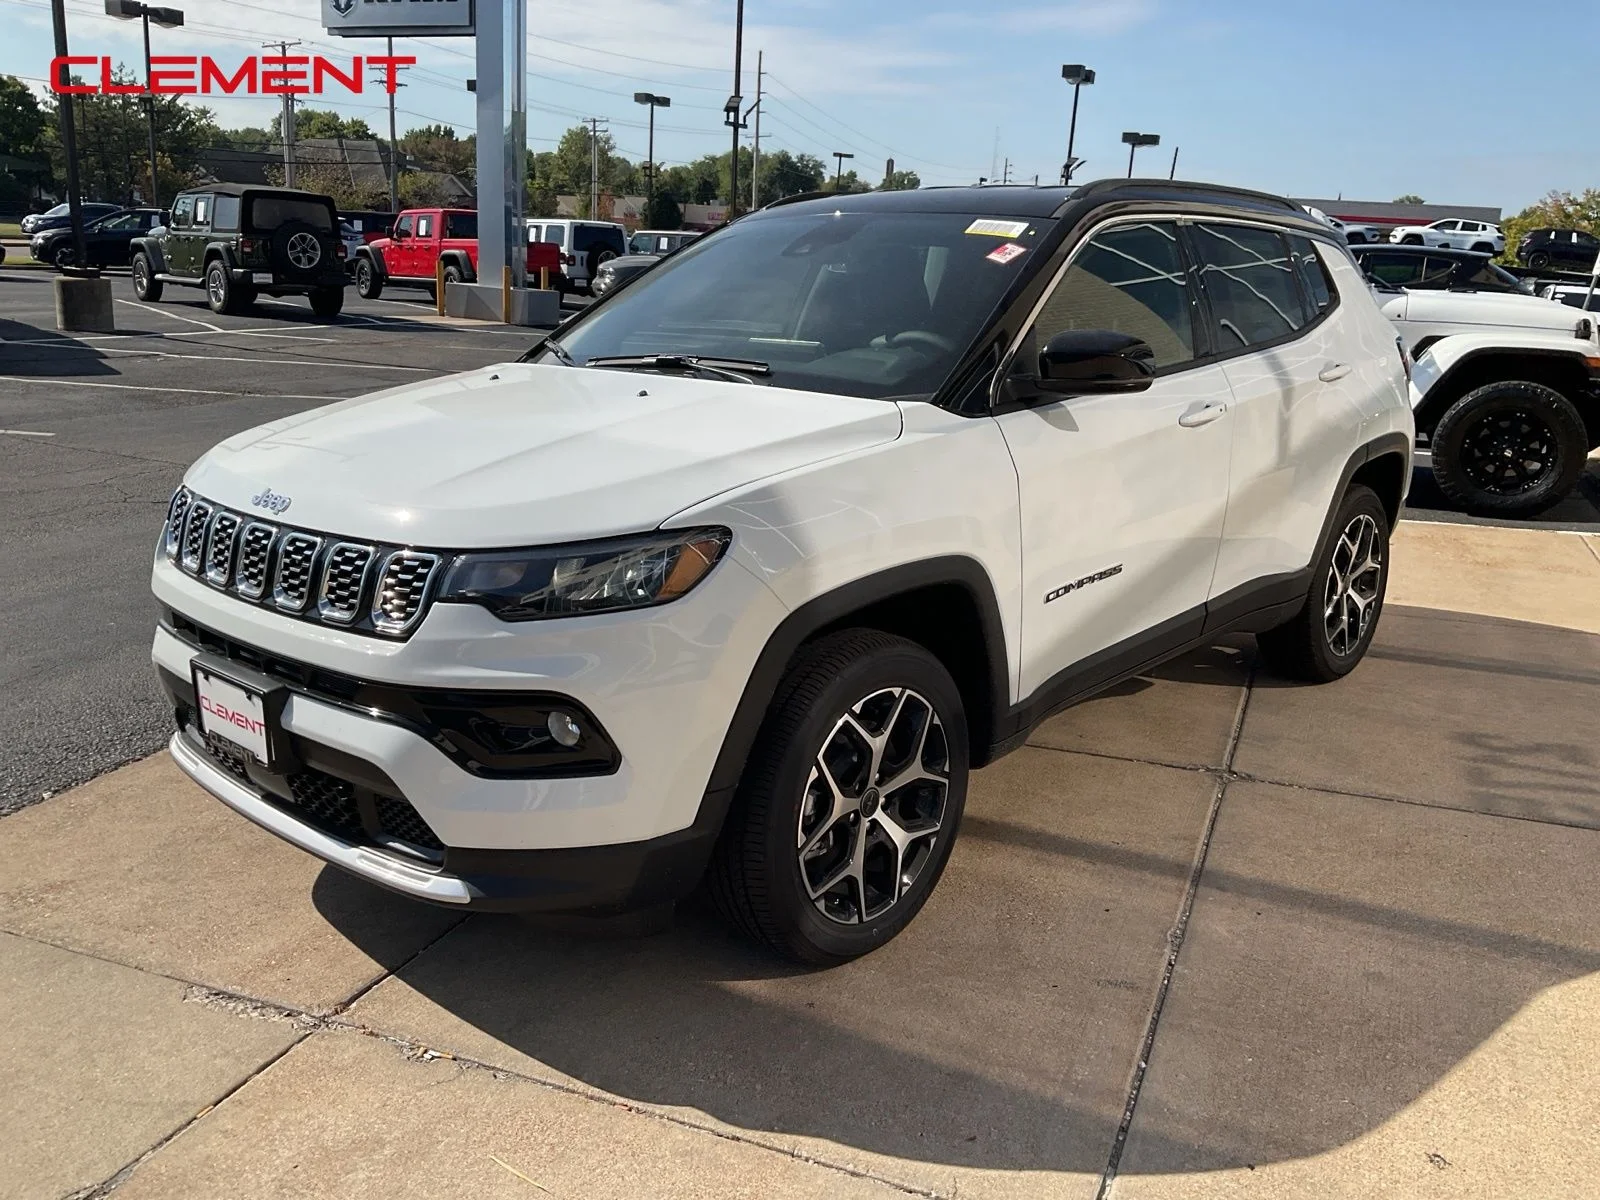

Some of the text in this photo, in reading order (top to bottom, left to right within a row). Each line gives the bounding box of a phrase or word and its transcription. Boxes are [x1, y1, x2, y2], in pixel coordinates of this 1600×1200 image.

[252, 488, 291, 516] Jeep
[1044, 564, 1123, 604] COMPASS
[201, 696, 266, 737] CLEMENT
